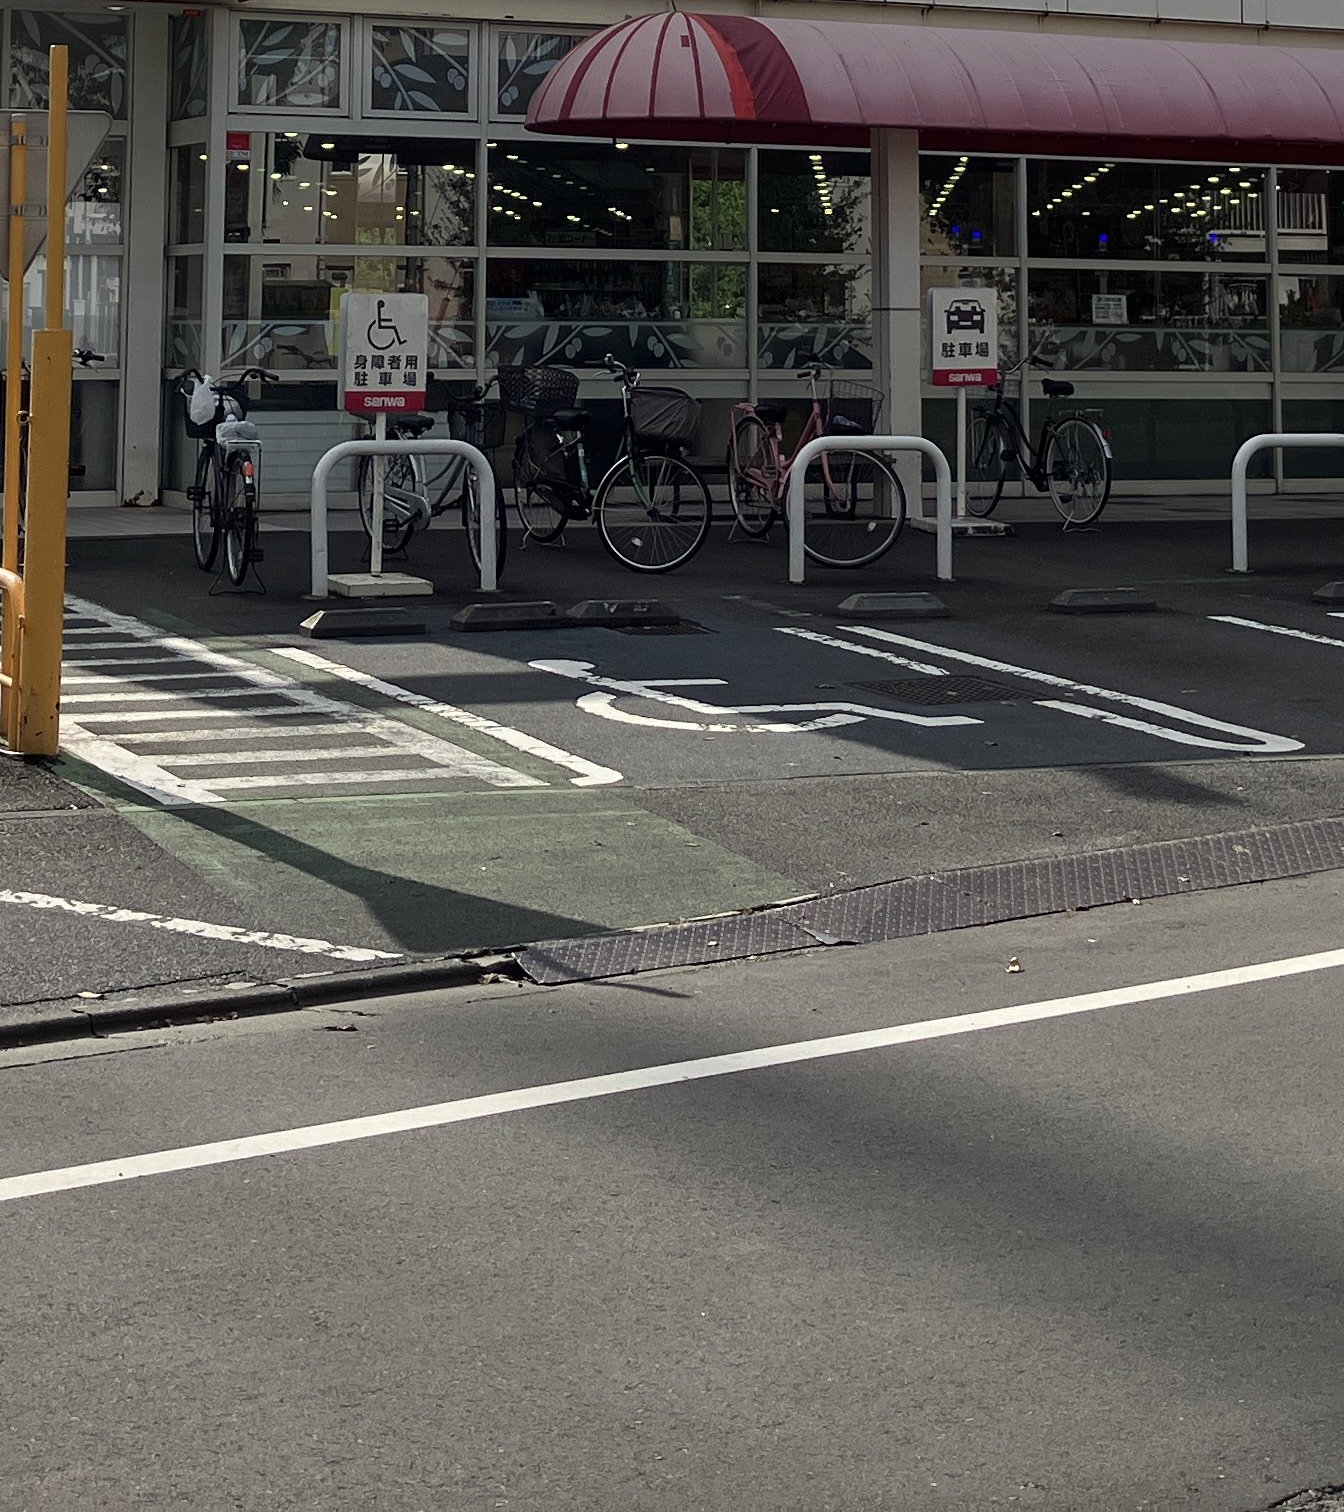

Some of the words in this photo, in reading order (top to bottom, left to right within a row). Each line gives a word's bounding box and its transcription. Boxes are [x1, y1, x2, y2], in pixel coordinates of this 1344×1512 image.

[942, 342, 989, 358] 駐車場
[353, 354, 418, 370] 身障者用
[353, 370, 418, 387] 駐車場
[949, 373, 982, 382] sanwa
[363, 395, 406, 408] sanwa
